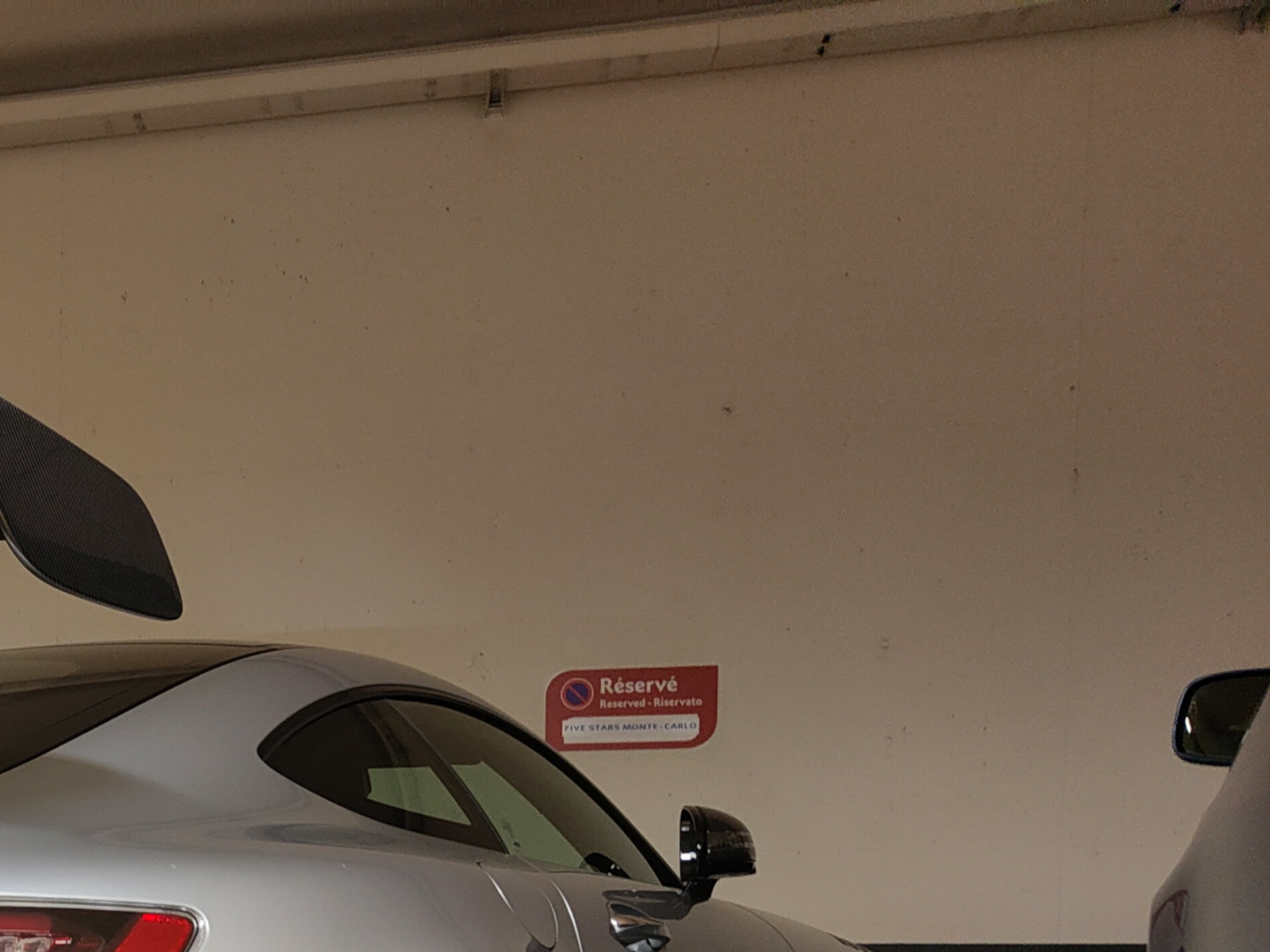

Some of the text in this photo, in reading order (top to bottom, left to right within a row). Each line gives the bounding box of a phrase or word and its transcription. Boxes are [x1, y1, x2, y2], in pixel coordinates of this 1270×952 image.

[600, 675, 678, 695] Réservé
[600, 698, 646, 709] Reserved
[654, 696, 703, 708] Riservato
[588, 724, 620, 732] STARS
